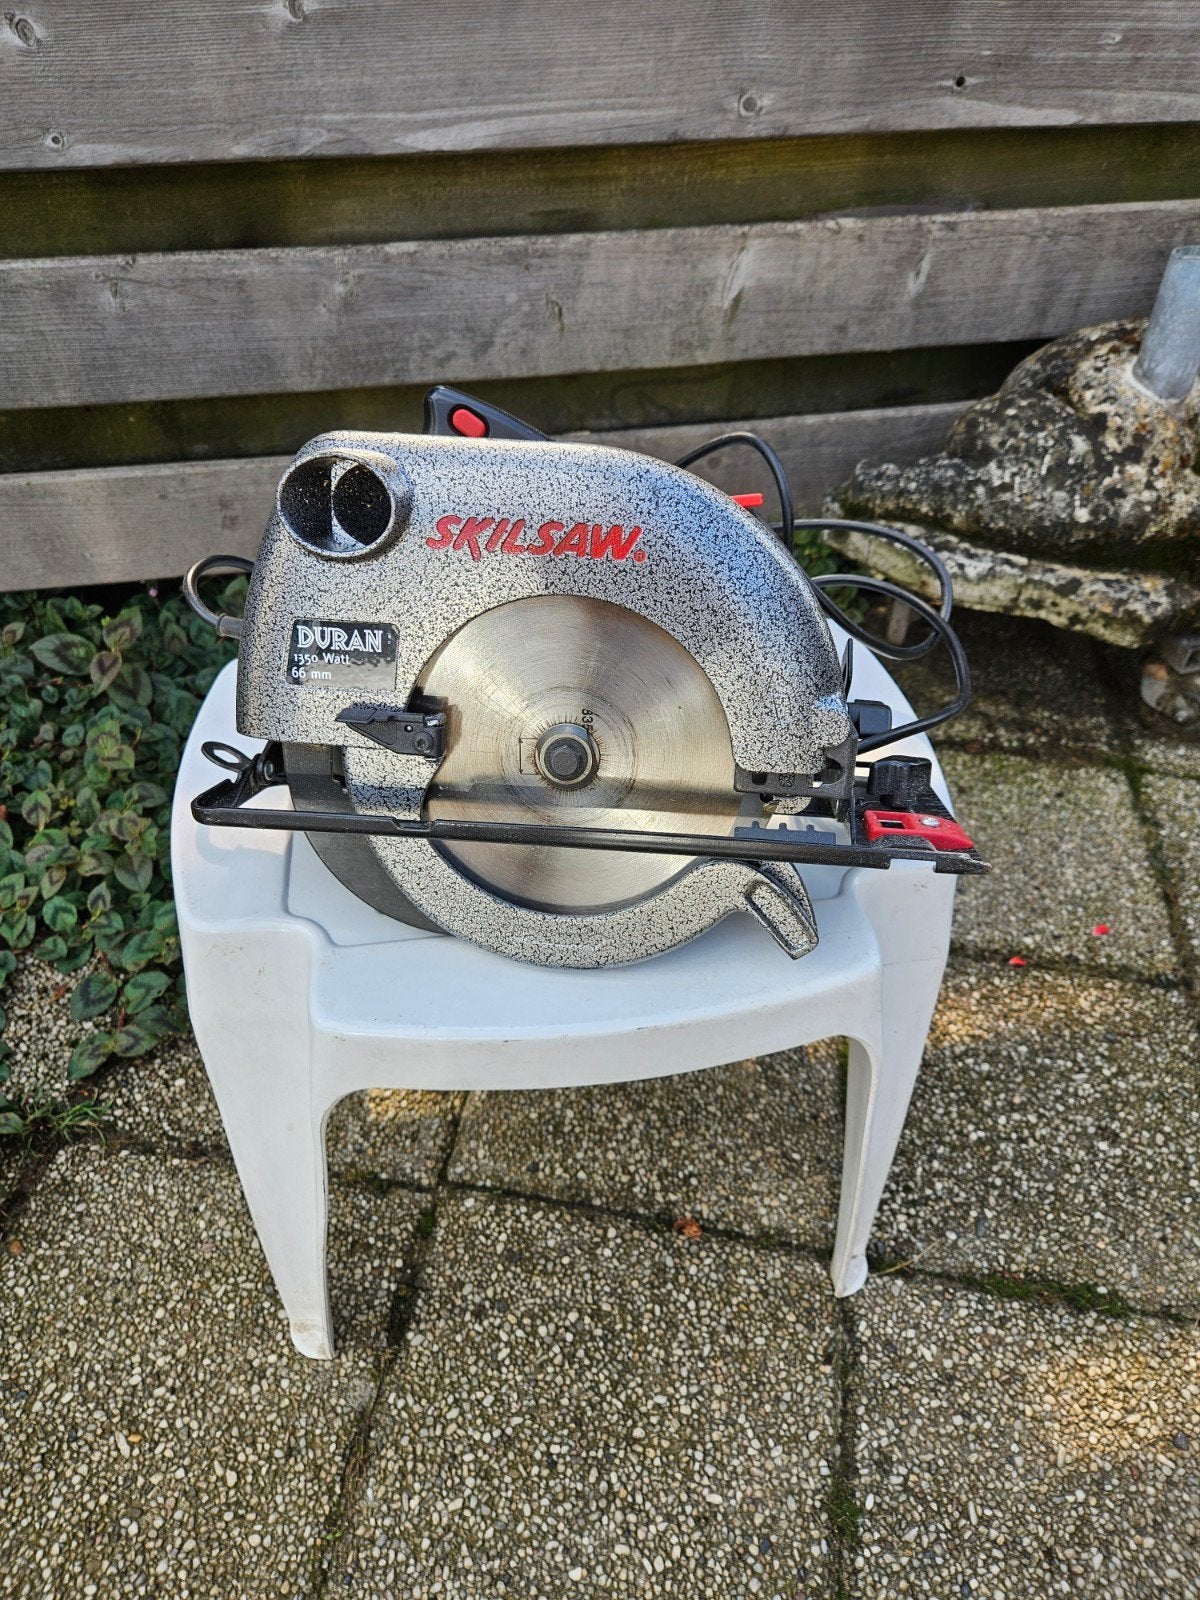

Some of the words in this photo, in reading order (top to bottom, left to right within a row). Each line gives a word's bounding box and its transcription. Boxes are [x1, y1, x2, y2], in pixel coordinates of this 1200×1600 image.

[296, 625, 383, 653] DURAN
[293, 653, 319, 665] 1350
[322, 652, 350, 665] Watt
[291, 666, 306, 679] 66
[311, 670, 332, 680] mm
